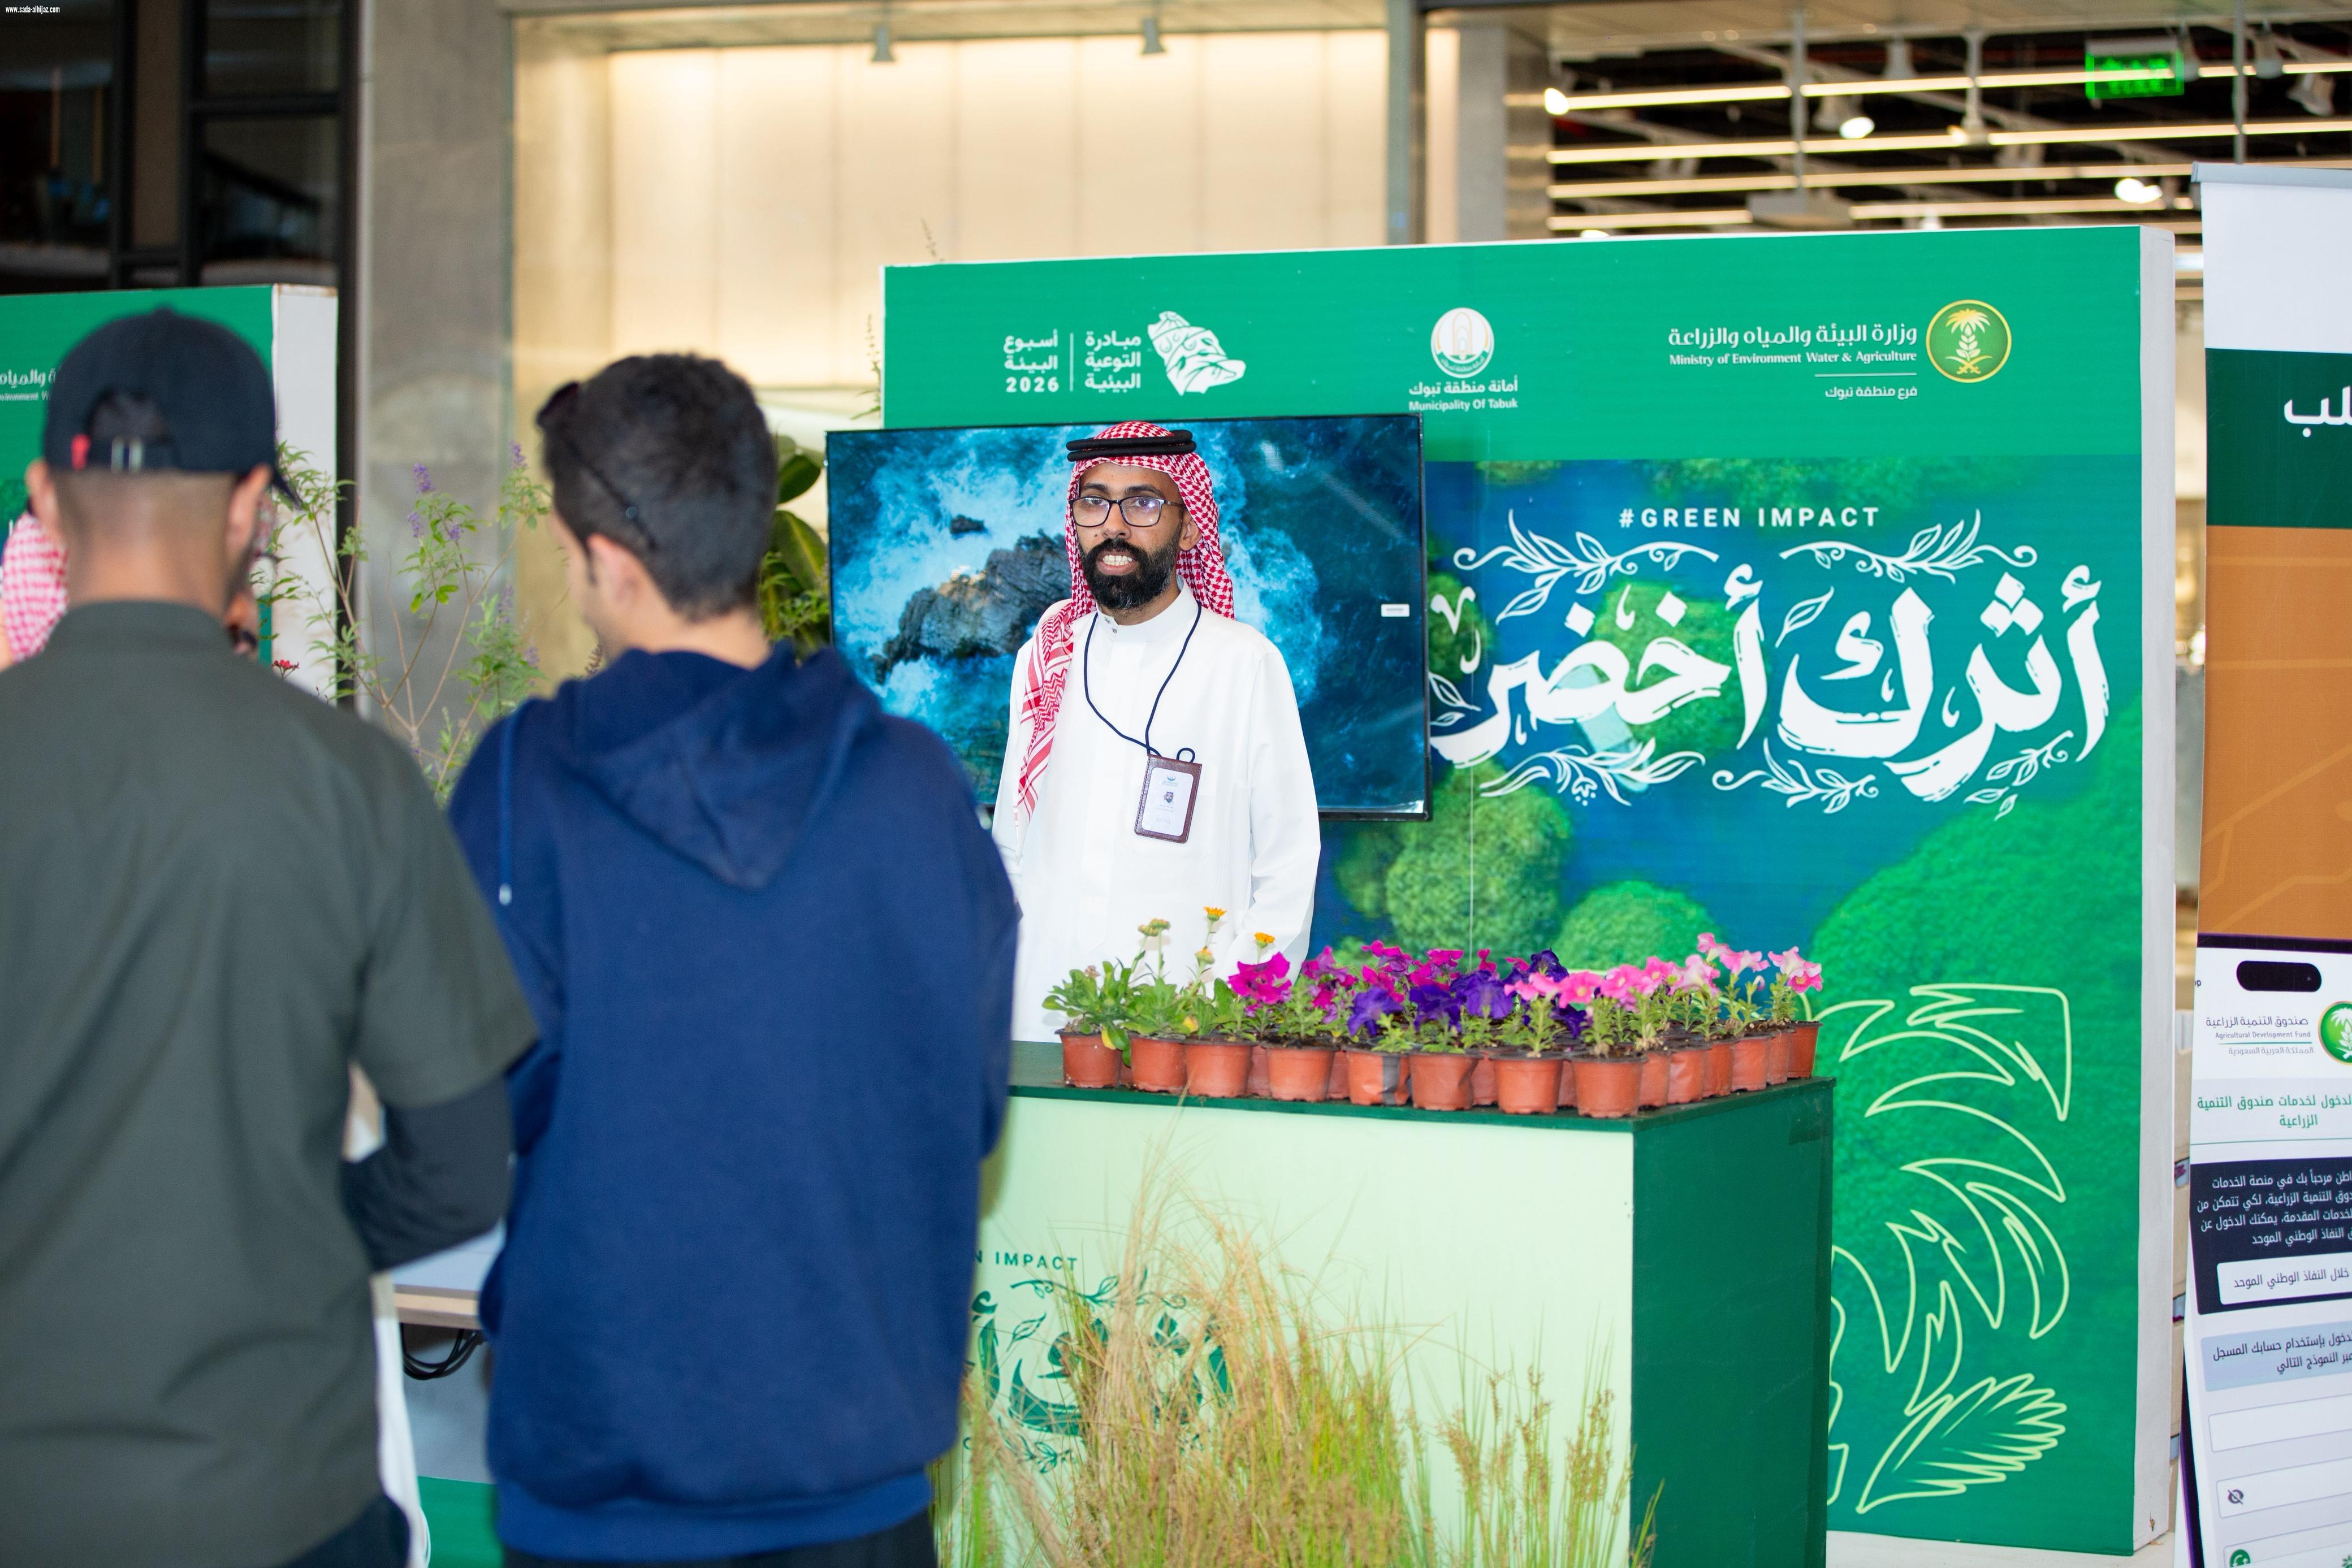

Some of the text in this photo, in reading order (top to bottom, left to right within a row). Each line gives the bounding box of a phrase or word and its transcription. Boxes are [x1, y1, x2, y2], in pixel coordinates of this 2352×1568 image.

[1004, 328, 1058, 354] أسبوع
[1085, 330, 1142, 350] مبادرة
[1668, 323, 1917, 349] وزارة البيئة والمياه والزراعة
[1004, 355, 1058, 374] البيئة
[1084, 351, 1141, 372] التوعية
[1670, 350, 1917, 367] Ministry of Environment Water & Agriculture
[1006, 376, 1059, 393] 2026
[1084, 372, 1141, 393] البيئية
[1408, 374, 1518, 397] أمانة منطقة تبوك
[1824, 385, 1918, 401] فرع منطقة تبوك
[1408, 397, 1518, 412] Municipality Of Tabuk
[2284, 385, 2352, 438] لب
[1619, 507, 1879, 528] #GREEN IMPACT
[1428, 563, 2108, 803] أثرك أخضر
[2206, 1016, 2308, 1029] صندوق التنمية الزراعية
[2215, 1031, 2251, 1041] Agricultural
[2252, 1031, 2293, 1039] Development
[2228, 1046, 2314, 1057] المملكة العربية السعودية
[2197, 1094, 2352, 1111] لدخول لخدمات صندوق التنمية
[2279, 1114, 2318, 1129] الزراعية
[2212, 1175, 2246, 1189] الخدمات
[2249, 1175, 2273, 1186] منصة
[2277, 1175, 2293, 1190] في
[2296, 1172, 2308, 1186] بك
[2212, 1196, 2239, 1211] تتمكن
[2242, 1194, 2262, 1211] لكي
[2303, 1190, 2332, 1205] التنمية
[2197, 1201, 2209, 1213] من
[2323, 1208, 2352, 1220] لخدمات
[2201, 1220, 2212, 1233] عن
[2216, 1214, 2246, 1231] الدخول
[2249, 1212, 2278, 1226] يمكنك
[2252, 1231, 2282, 1246] الموحد
[2285, 1228, 2318, 1248] الوطني
[2321, 1227, 2345, 1240] النفاذ
[995, 1251, 1077, 1270] IMPACT
[2234, 1267, 2349, 1290] خلال النفاذ الوطني الموحد
[2251, 1340, 2282, 1355] حسابك
[2285, 1334, 2325, 1353] بإستخدام
[2213, 1343, 2248, 1362] المسجل
[2306, 1352, 2338, 1370] النموذج
[2277, 1355, 2303, 1375] التالي
